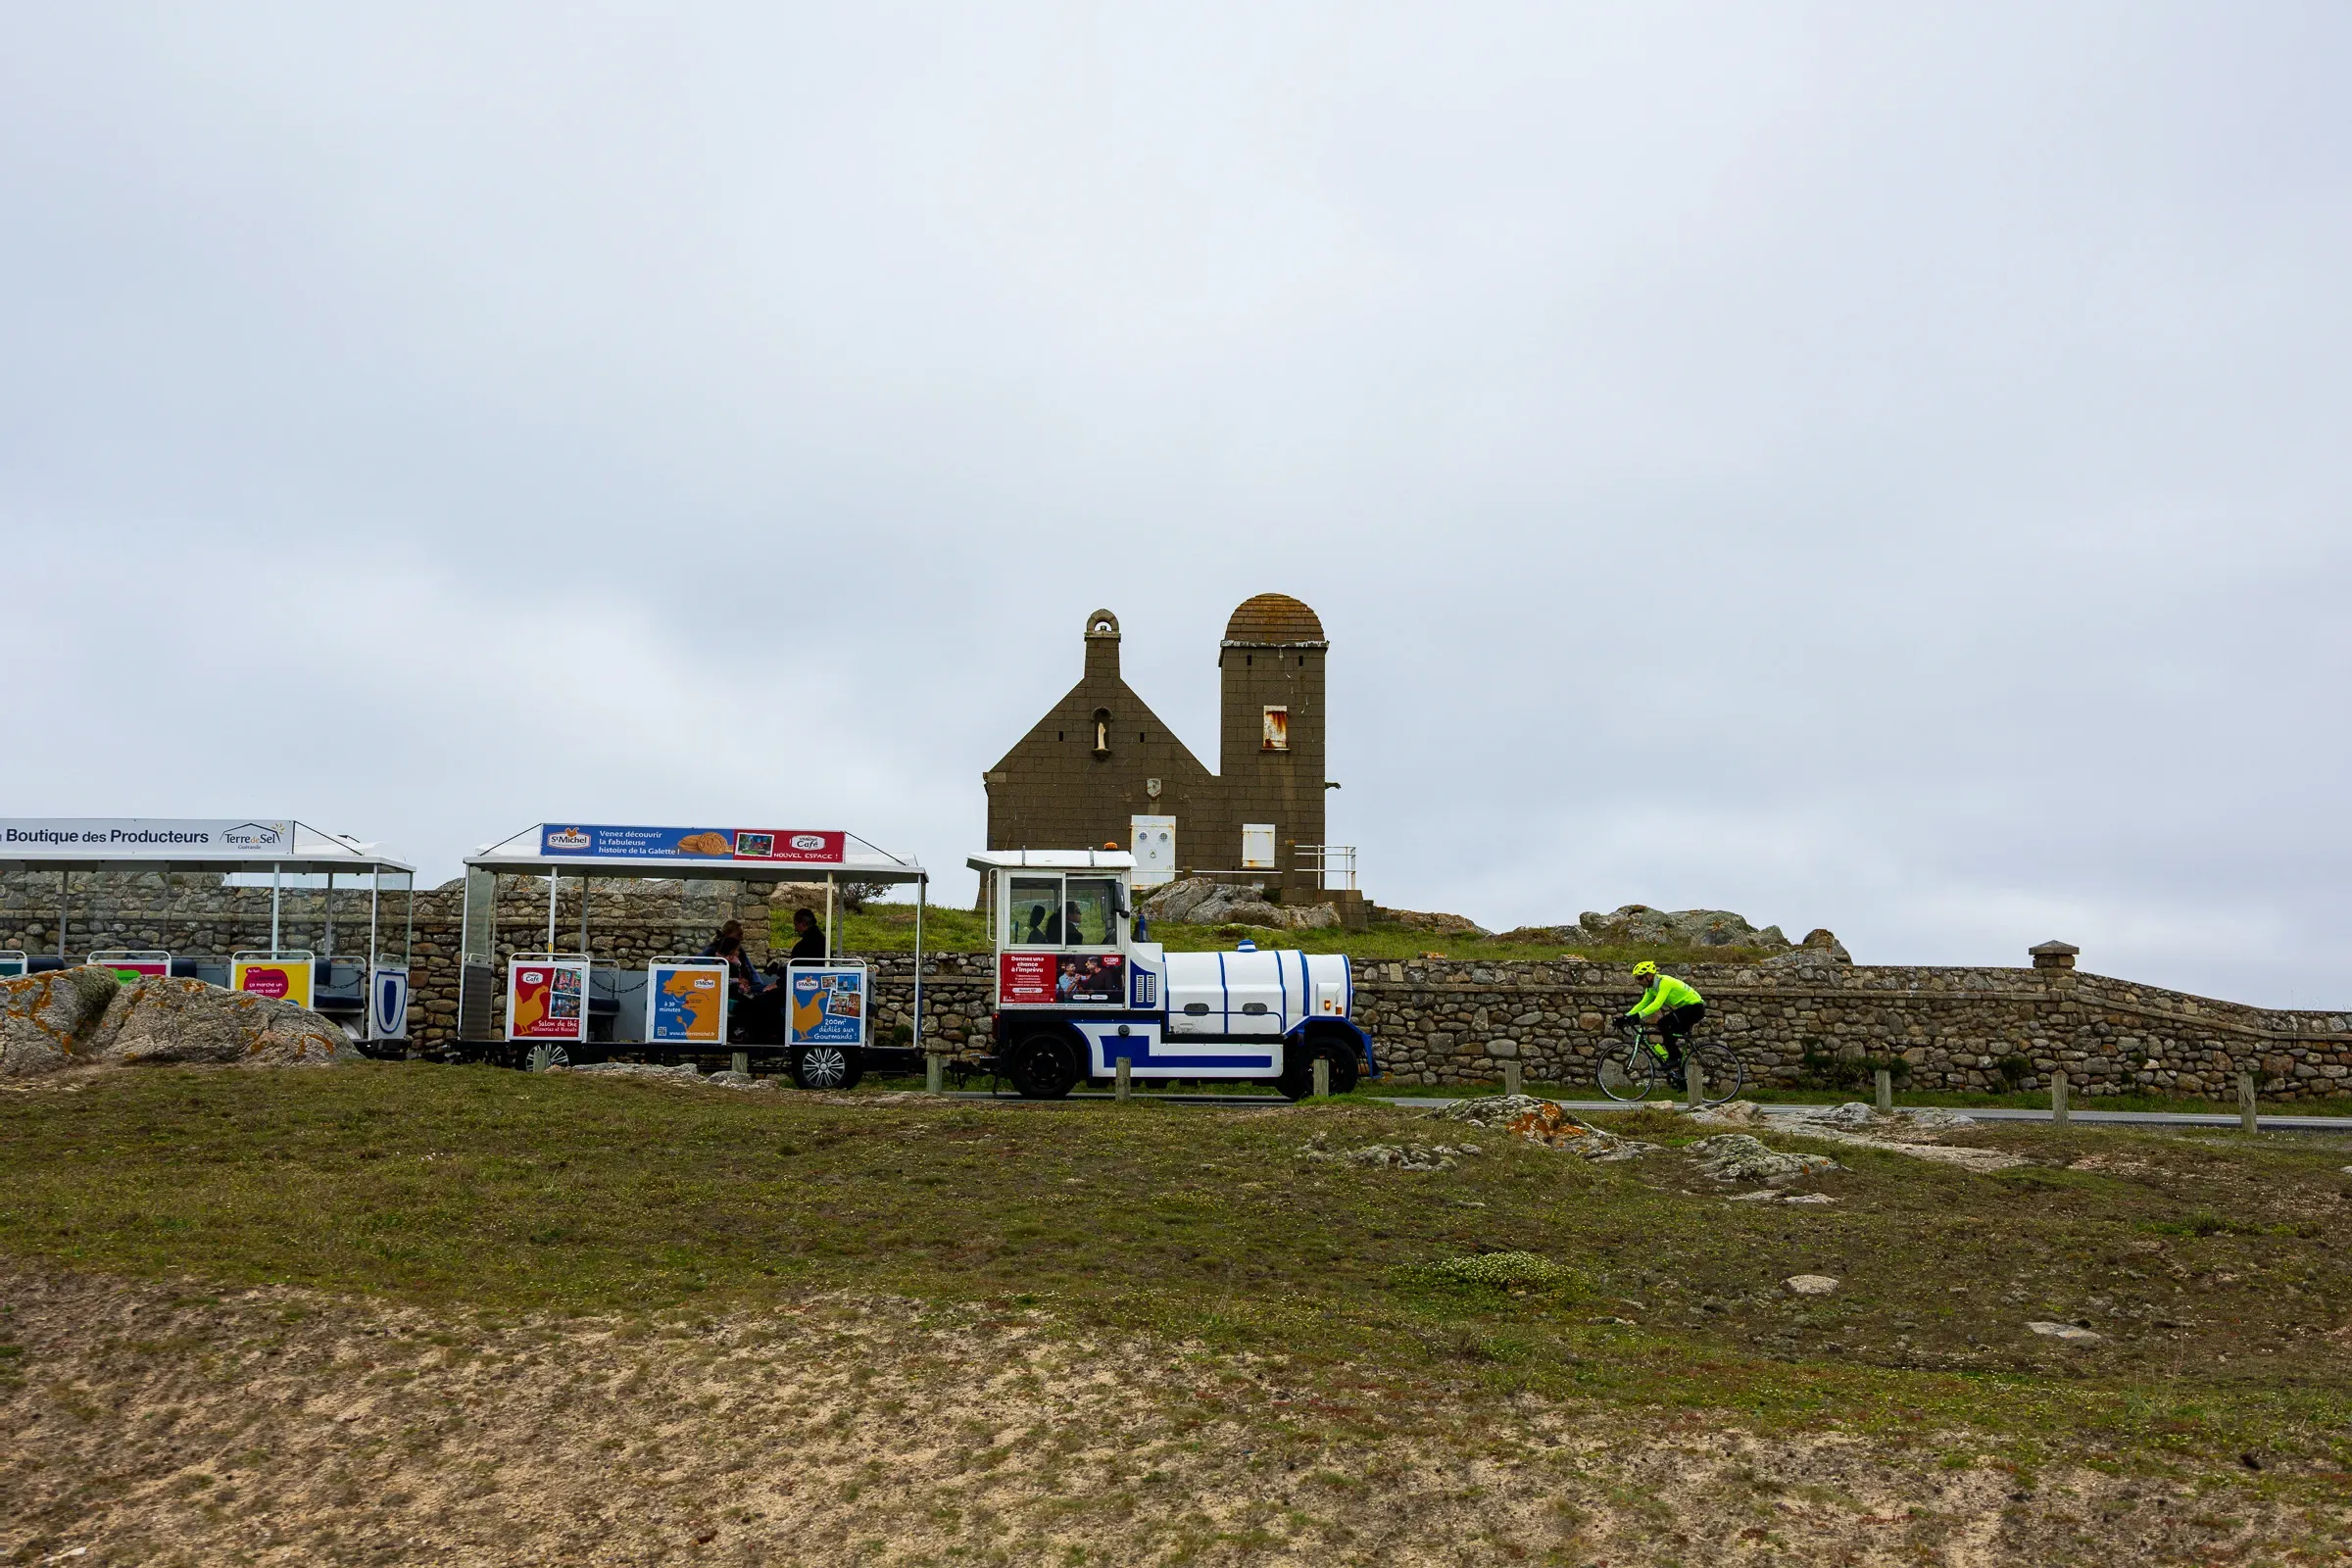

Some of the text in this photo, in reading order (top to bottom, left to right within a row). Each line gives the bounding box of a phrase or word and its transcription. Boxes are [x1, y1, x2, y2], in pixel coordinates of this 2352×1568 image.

[6, 828, 79, 845] Boutique
[81, 831, 107, 843] des
[110, 829, 210, 844] Producteurs
[797, 840, 818, 849] Café
